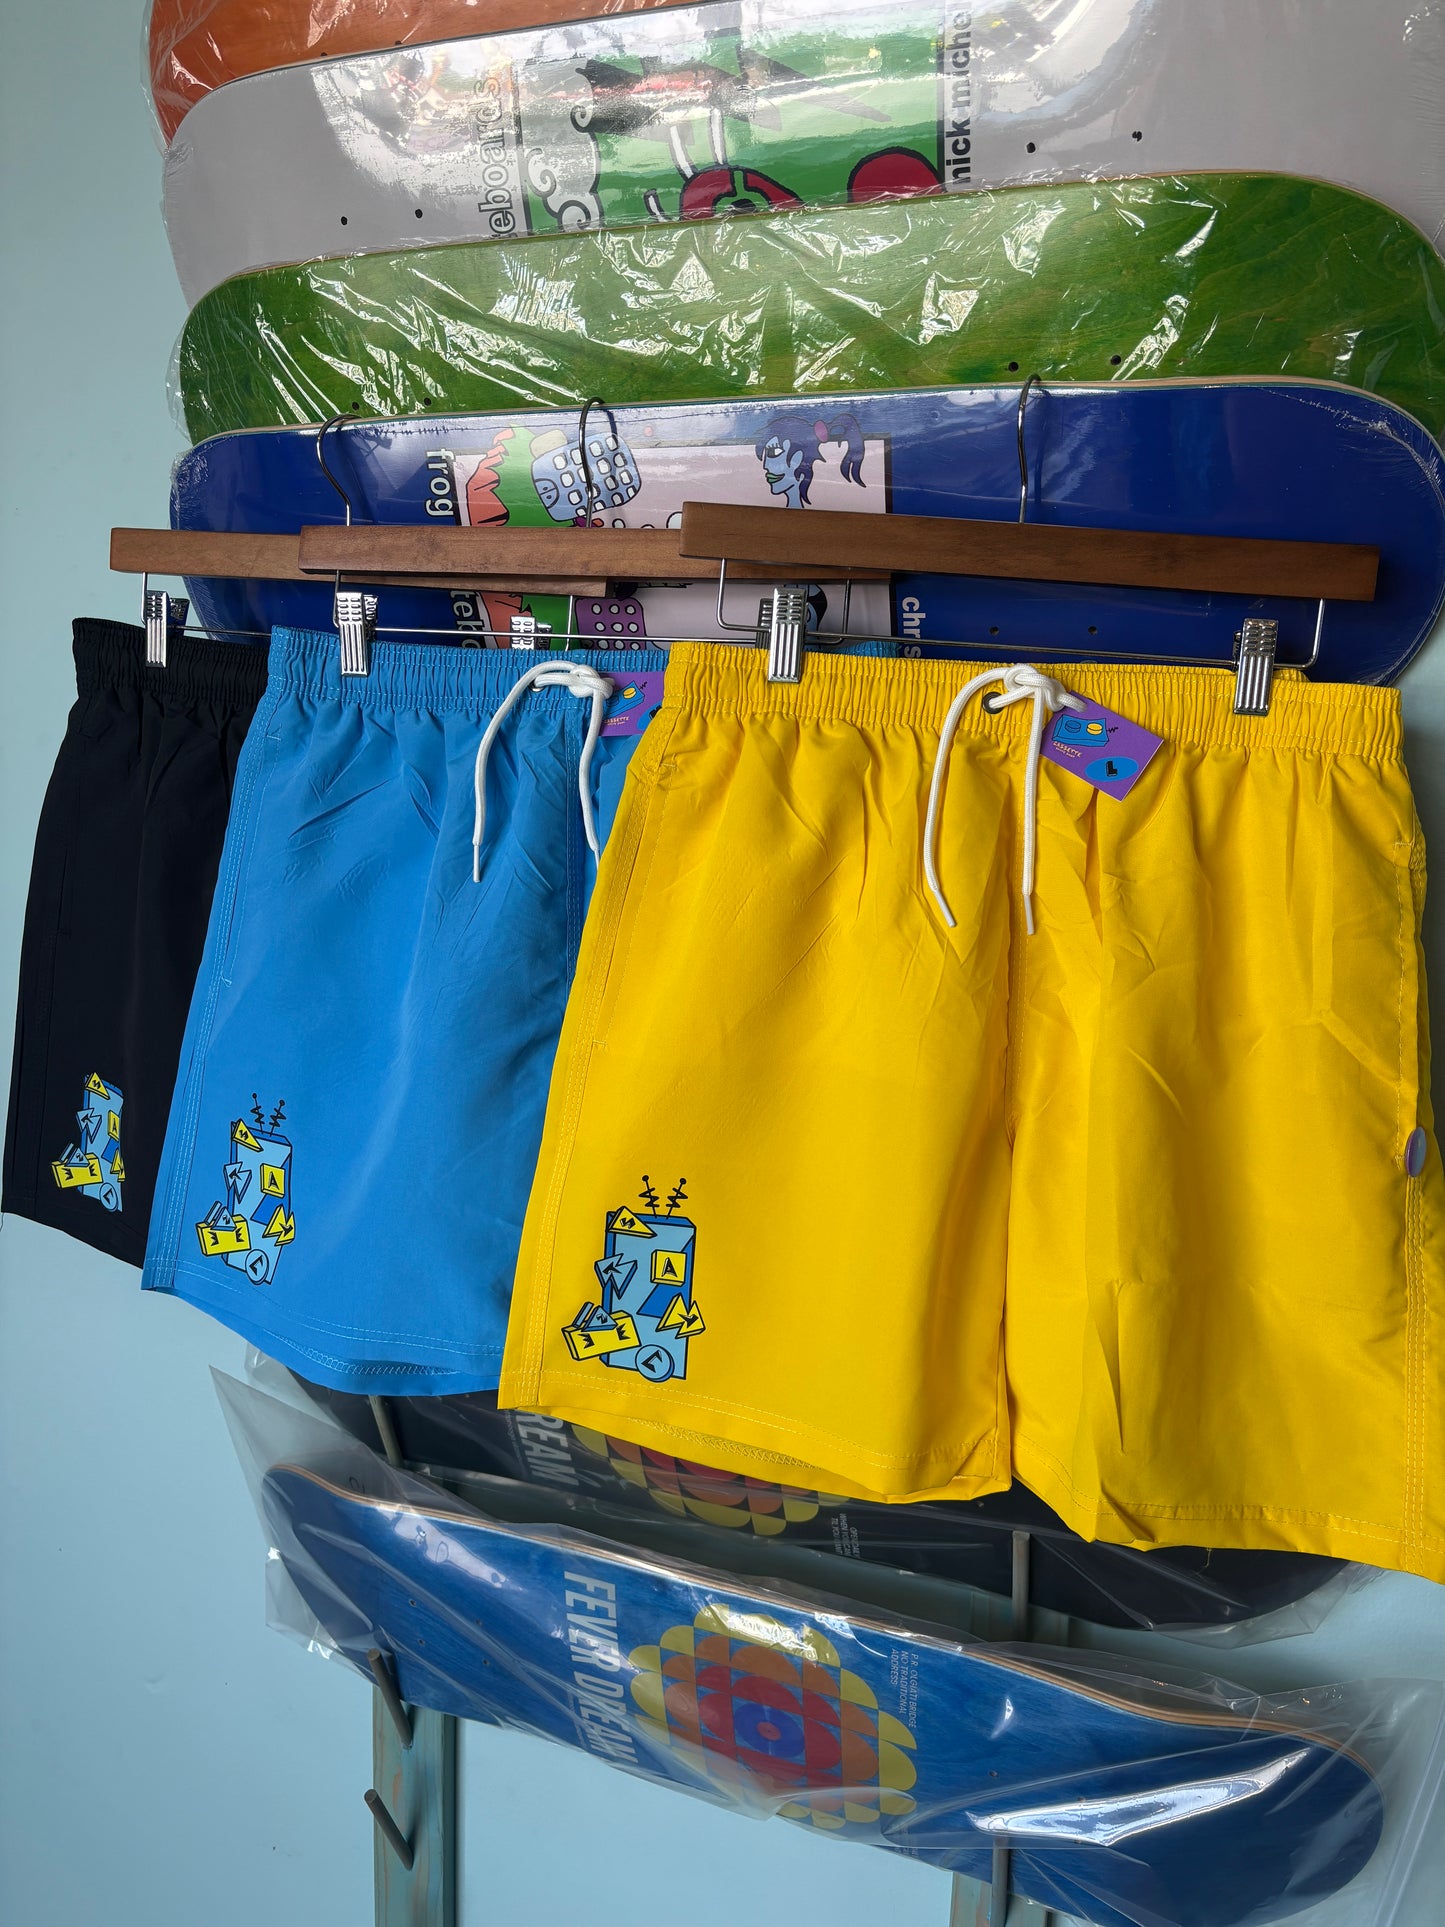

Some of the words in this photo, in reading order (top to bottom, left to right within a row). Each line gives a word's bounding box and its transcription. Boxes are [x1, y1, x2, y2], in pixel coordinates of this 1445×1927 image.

[466, 77, 518, 238] eboards
[945, 116, 972, 184] nick
[425, 448, 454, 517] frog
[902, 596, 926, 659] chrs
[1105, 760, 1118, 777] L
[564, 1570, 621, 1673] FEVER
[899, 1665, 909, 1714] TRADITIONAL
[900, 1650, 909, 1664] NO
[573, 1671, 639, 1764] DREAM
[908, 1701, 917, 1728] BRIDGE
